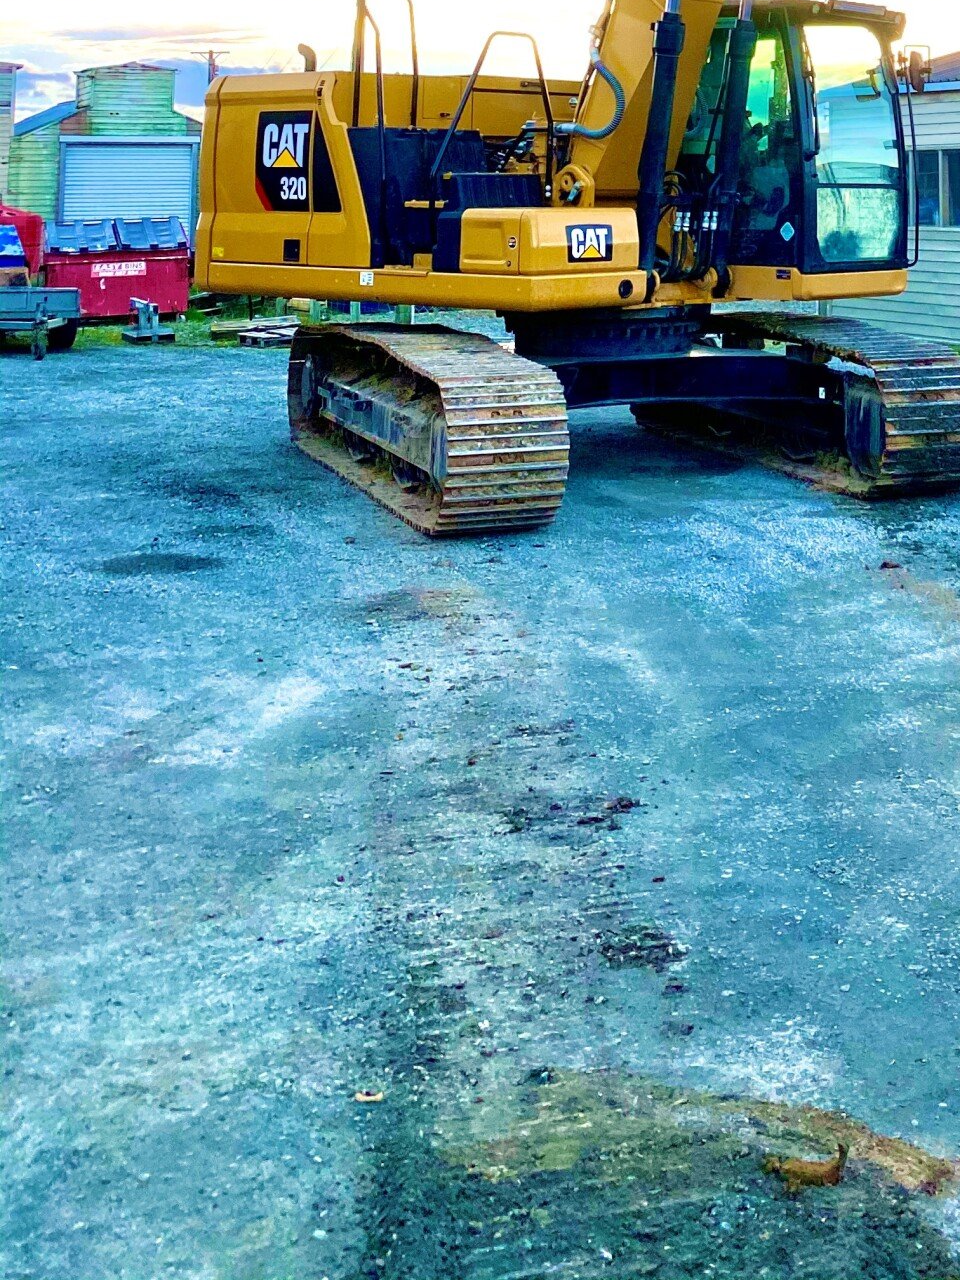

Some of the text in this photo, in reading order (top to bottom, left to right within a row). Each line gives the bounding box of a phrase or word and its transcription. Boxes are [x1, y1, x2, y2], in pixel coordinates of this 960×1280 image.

[262, 123, 309, 168] CAT
[280, 176, 307, 201] 320
[571, 228, 608, 259] CAT
